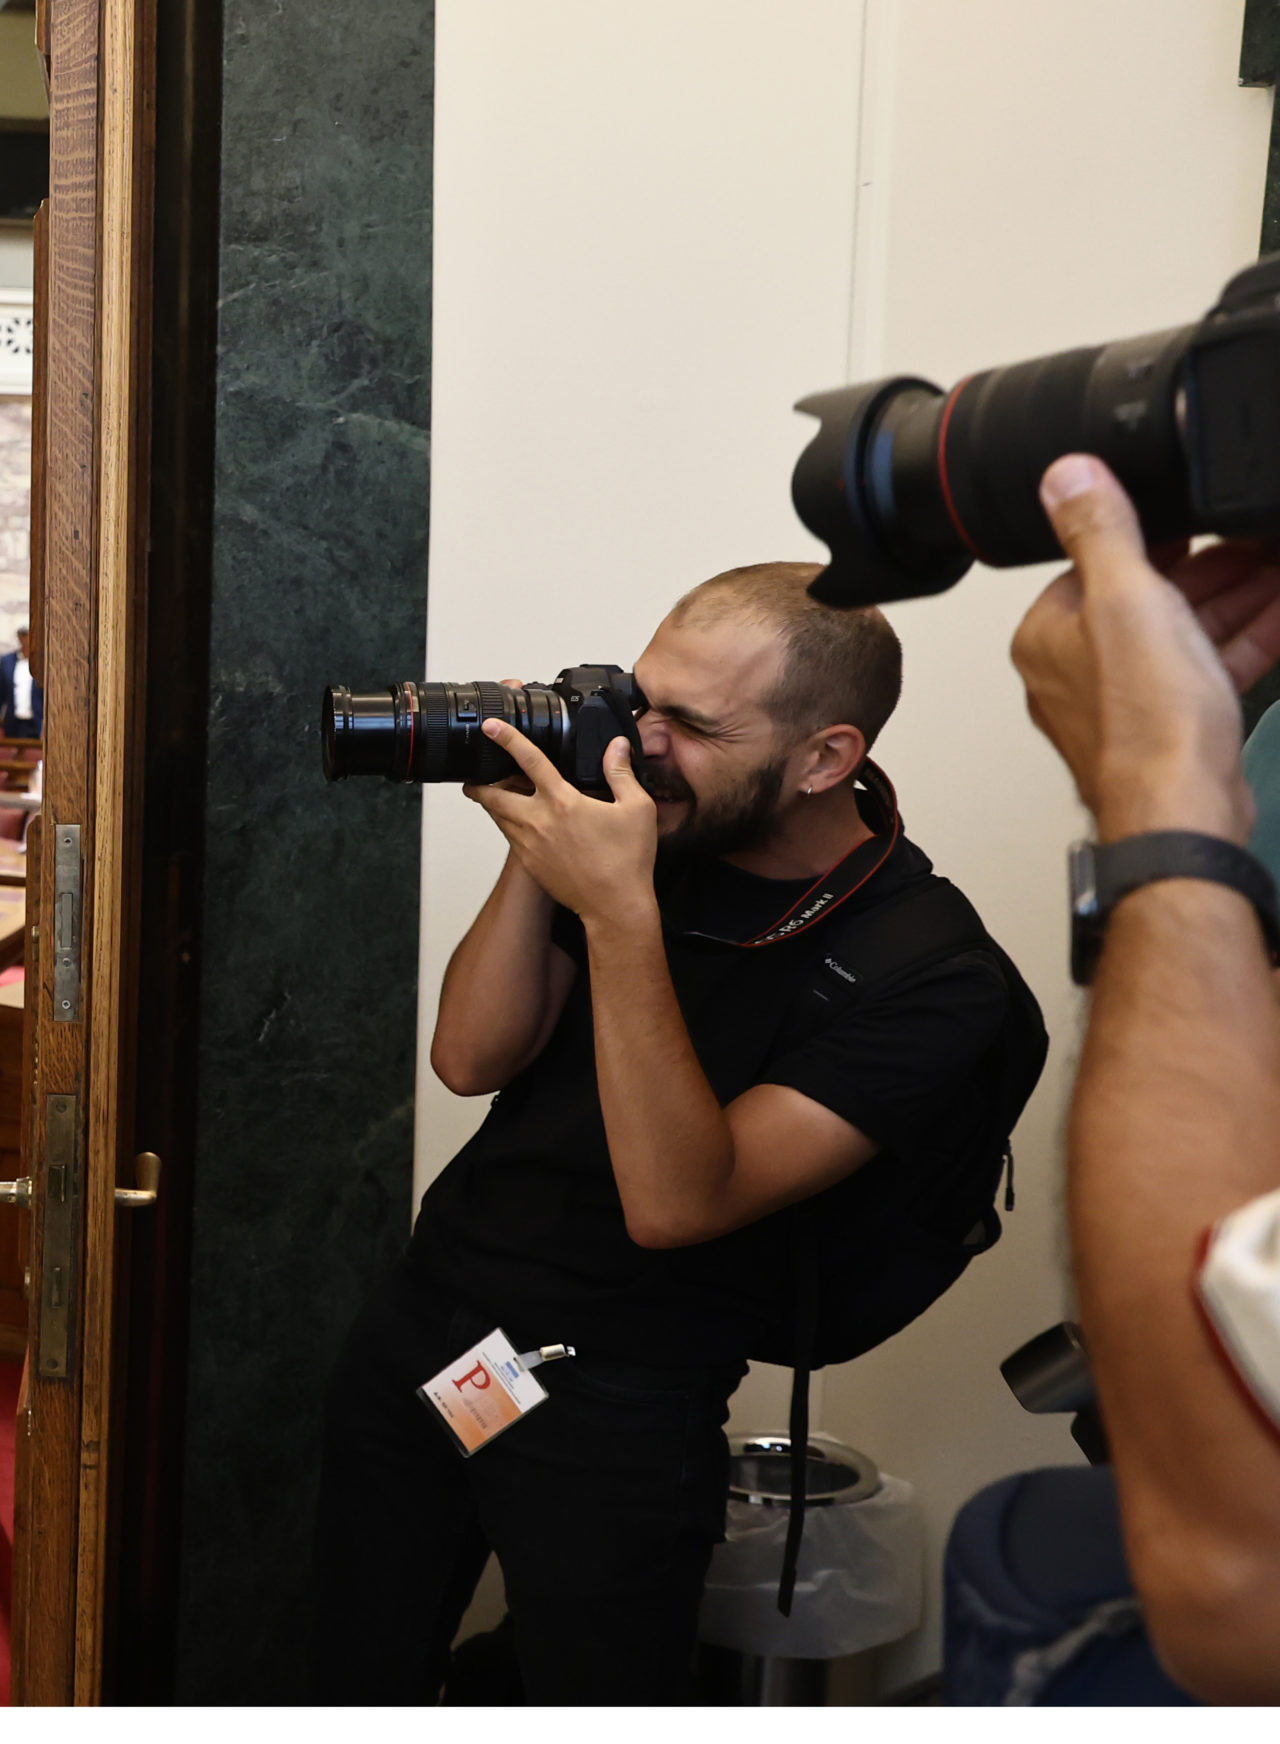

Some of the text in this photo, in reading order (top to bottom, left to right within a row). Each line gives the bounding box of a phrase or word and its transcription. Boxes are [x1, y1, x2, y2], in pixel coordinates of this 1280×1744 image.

[800, 899, 828, 919] Mark
[829, 961, 856, 983] Columbia
[452, 1360, 490, 1393] P
